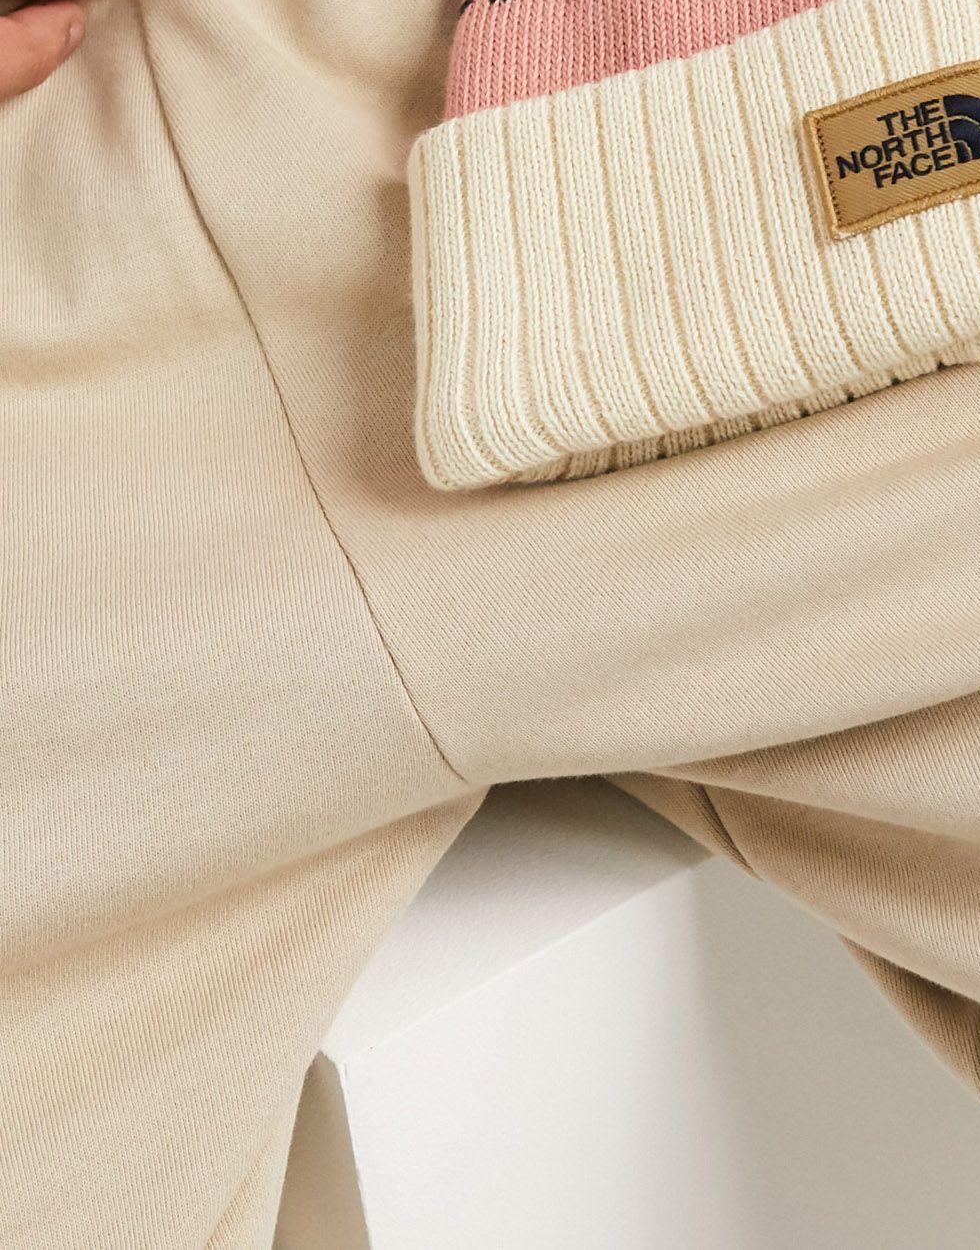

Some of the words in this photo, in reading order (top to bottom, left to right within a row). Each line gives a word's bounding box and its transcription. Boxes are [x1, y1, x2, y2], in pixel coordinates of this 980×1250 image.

[877, 99, 944, 136] THE
[836, 122, 950, 179] NORTH
[874, 146, 955, 187] FACE
